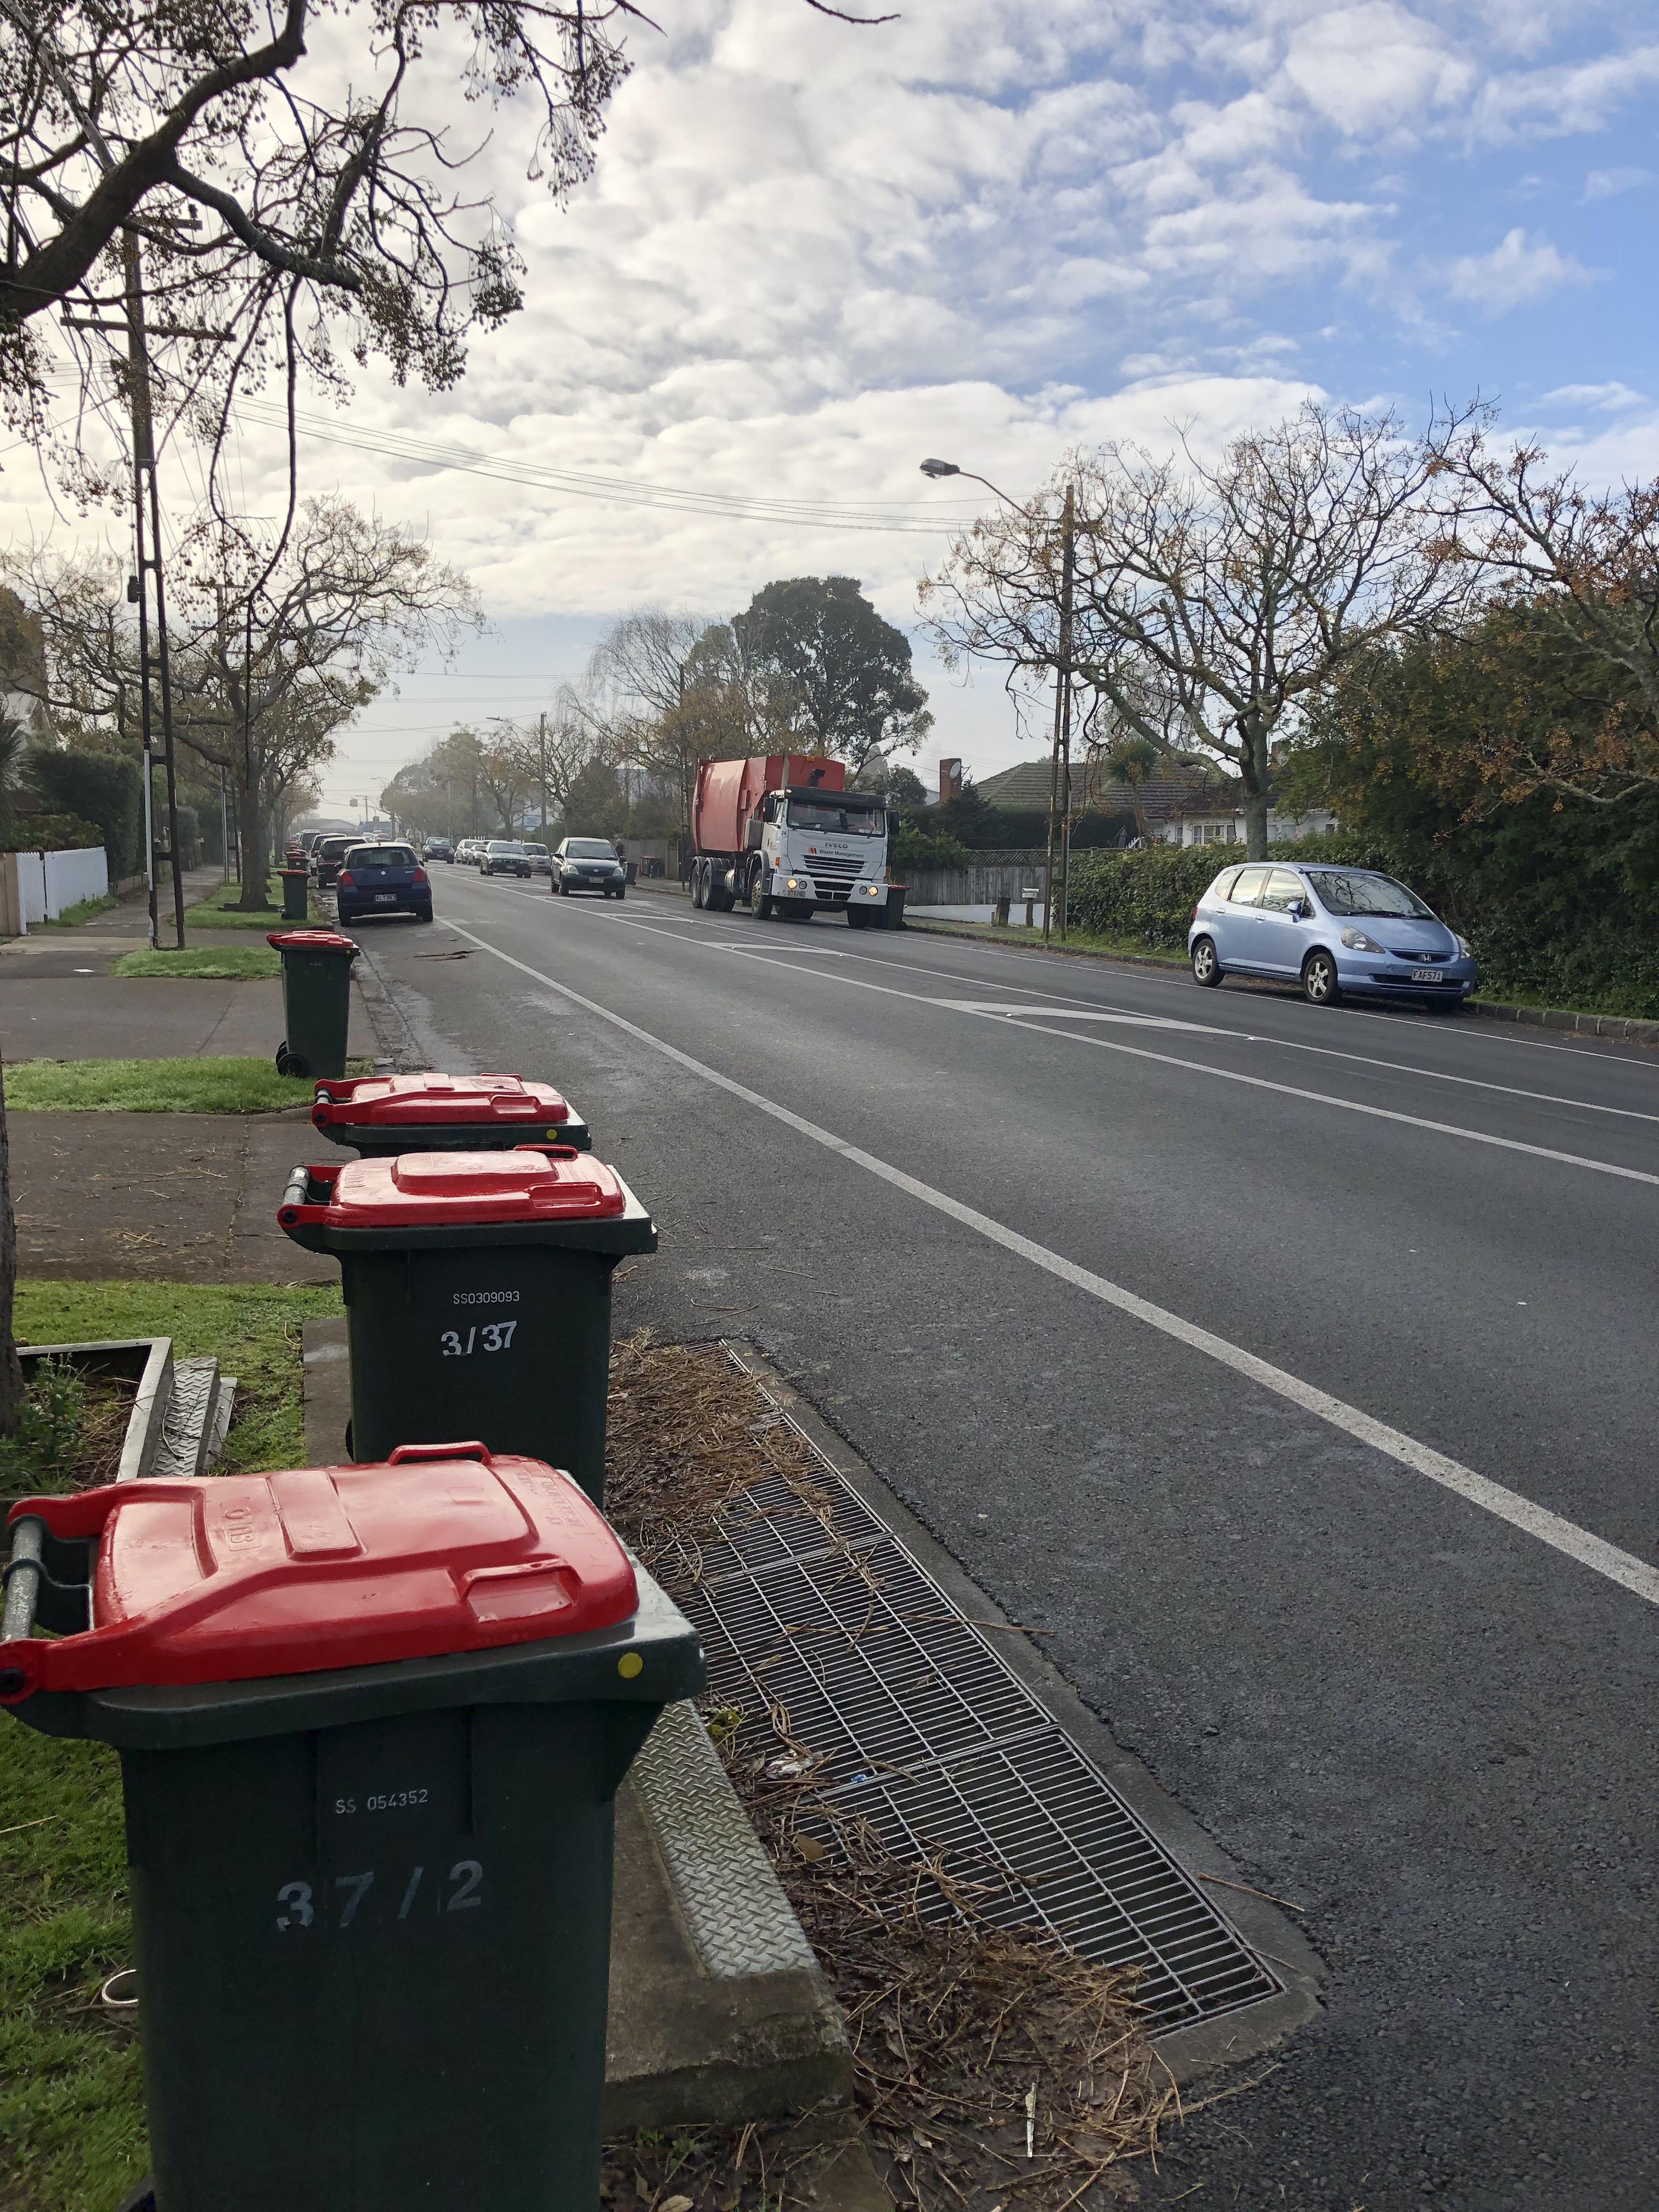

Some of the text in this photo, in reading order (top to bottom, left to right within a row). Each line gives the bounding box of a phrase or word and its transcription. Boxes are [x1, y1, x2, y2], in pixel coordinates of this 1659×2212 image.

[1413, 970, 1441, 980] FAF571
[453, 1290, 520, 1305] SS0309093
[335, 1788, 428, 1814] SS 054352
